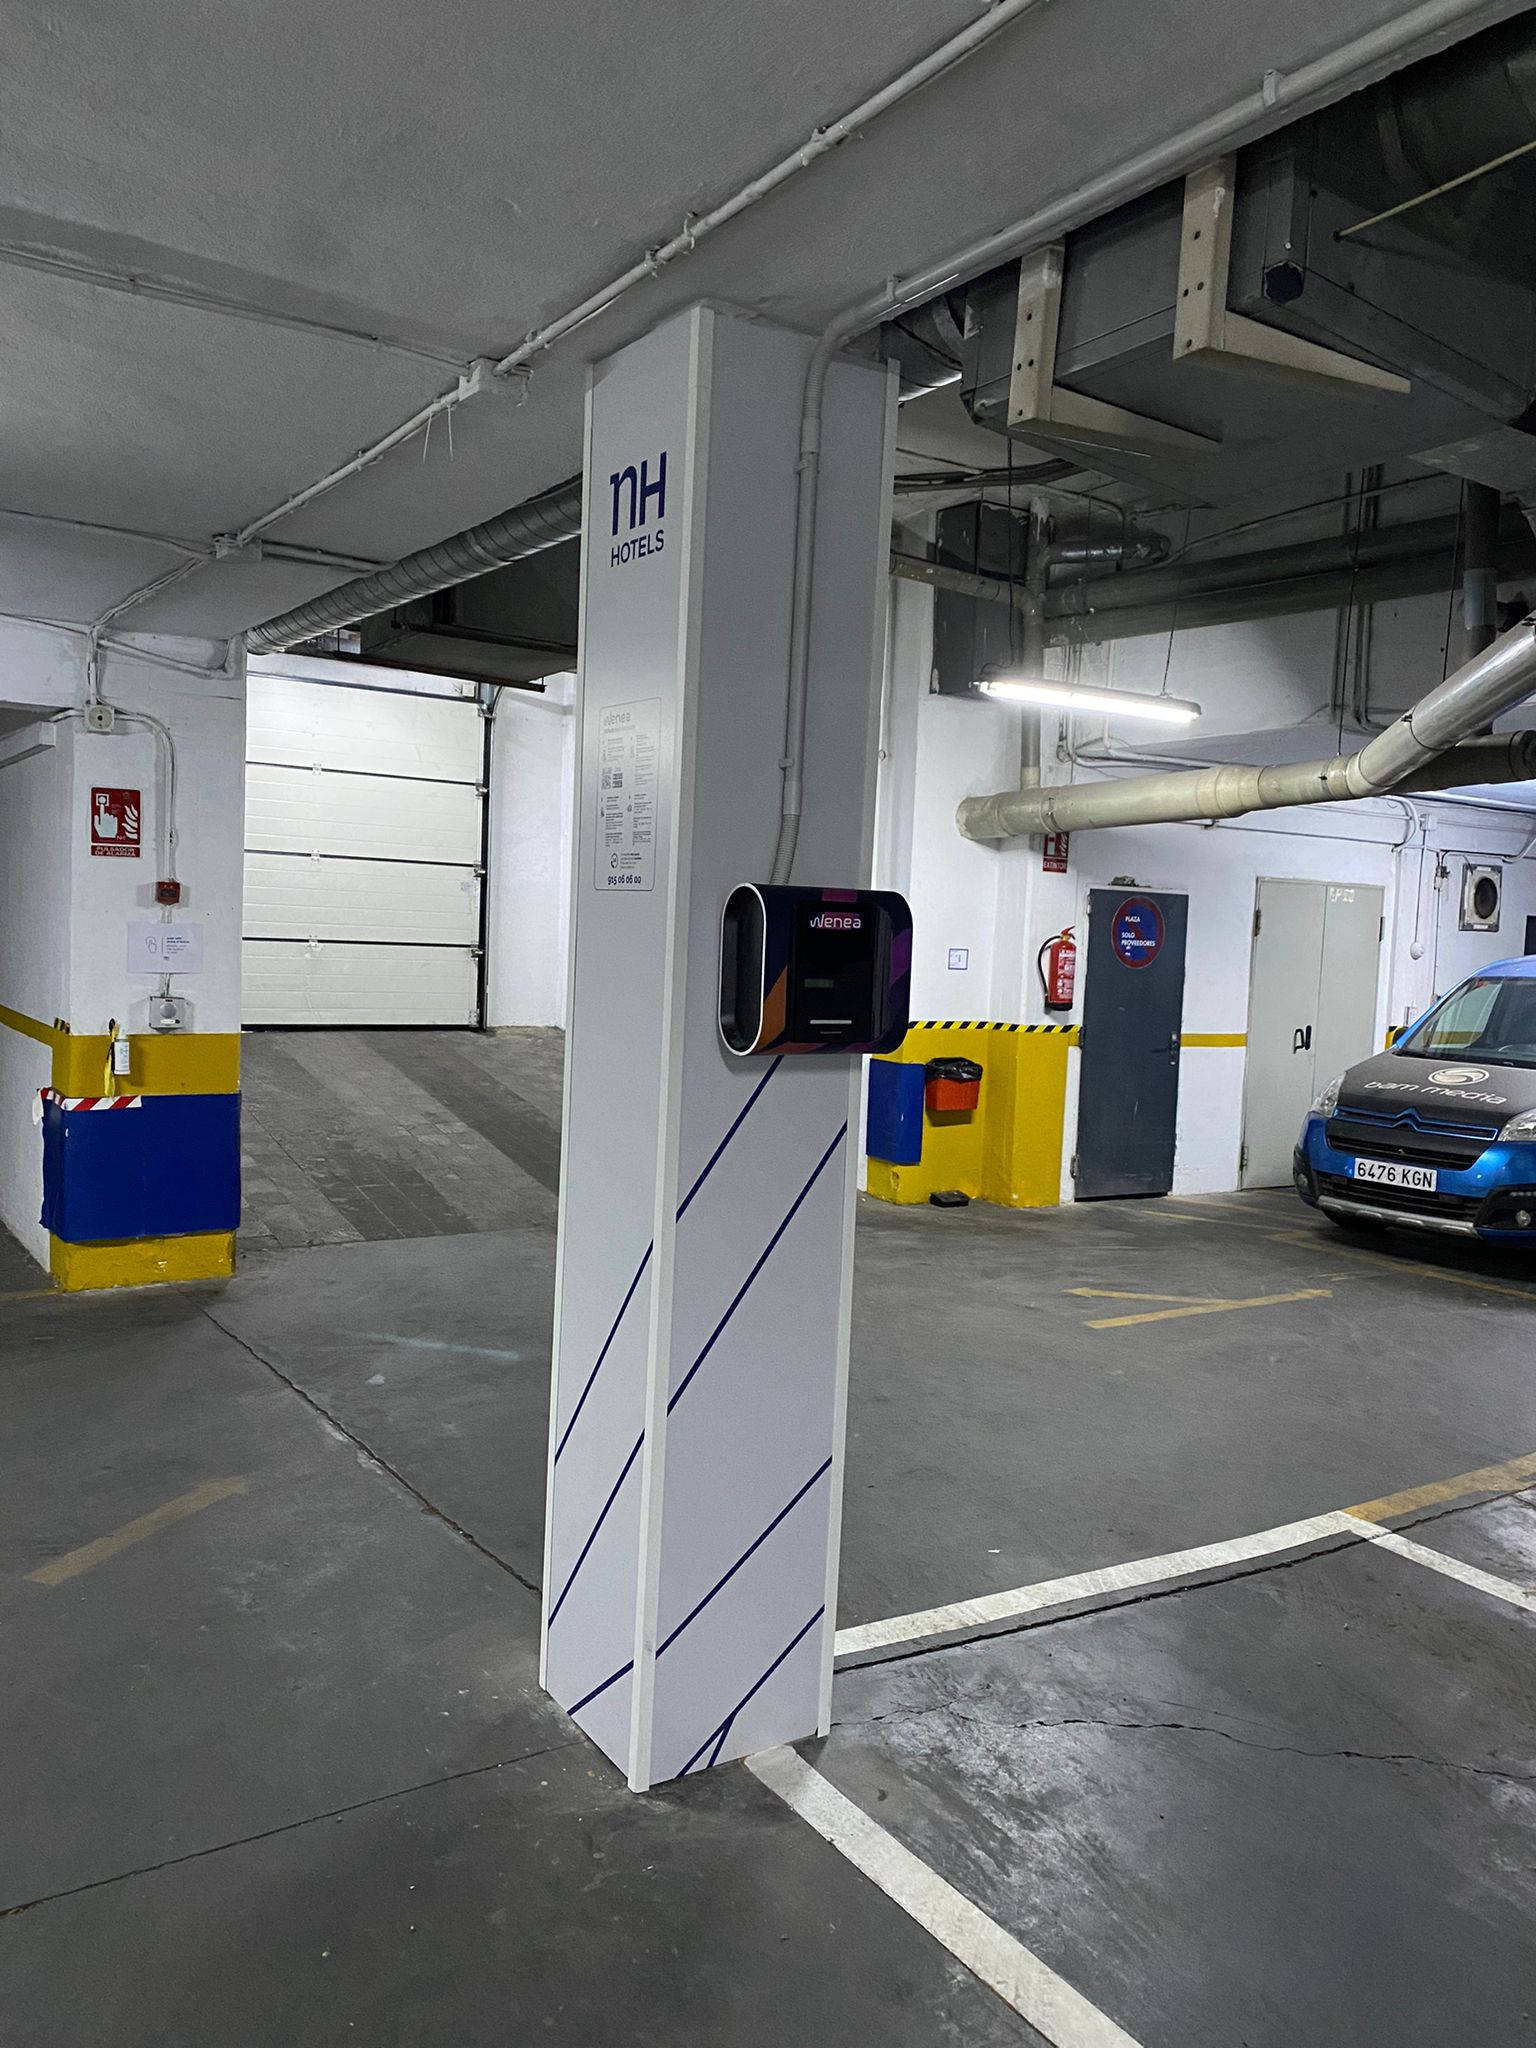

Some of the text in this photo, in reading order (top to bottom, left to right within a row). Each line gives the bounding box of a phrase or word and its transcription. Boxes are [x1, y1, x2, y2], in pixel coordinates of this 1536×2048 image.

[610, 529, 665, 568] HOTELS
[1124, 915, 1141, 923] PLAZA
[1121, 931, 1135, 939] SOLO
[1121, 939, 1156, 947] PROVEEDORES
[1420, 1086, 1508, 1105] media
[1357, 1162, 1433, 1188] 6476 KGN
